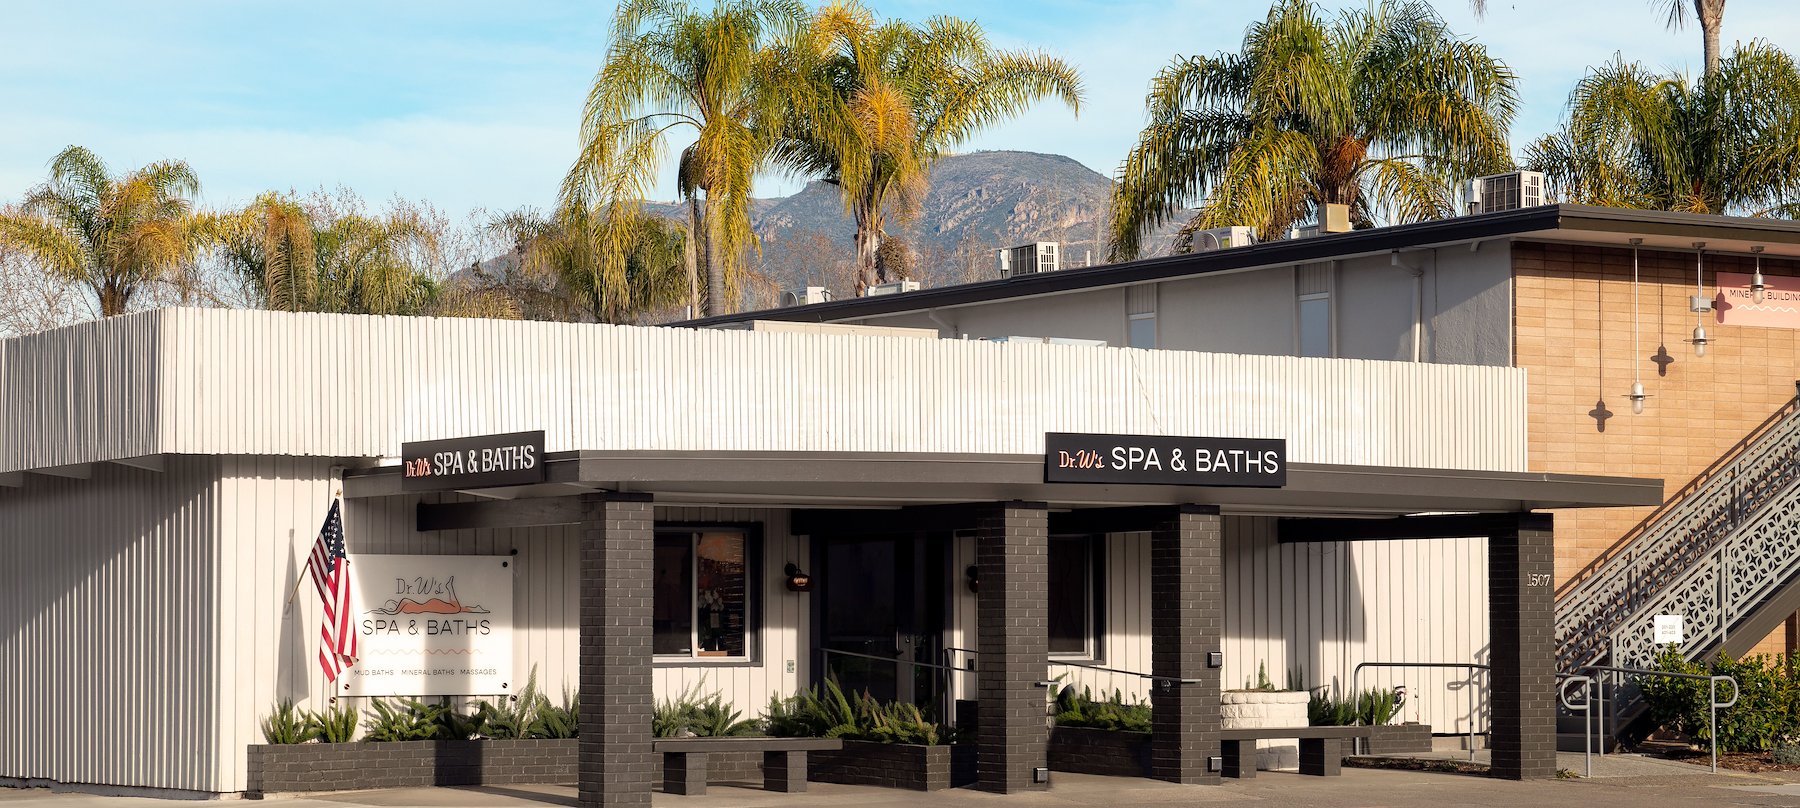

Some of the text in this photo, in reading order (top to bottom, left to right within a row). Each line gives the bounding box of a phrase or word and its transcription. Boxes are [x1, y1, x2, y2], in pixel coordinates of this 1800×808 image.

[1729, 289, 1765, 300] MINE
[434, 451, 464, 476] SPA
[467, 449, 478, 474] &
[482, 444, 535, 473] BATHS
[1111, 446, 1162, 471] SPA
[1170, 448, 1187, 471] &
[1195, 449, 1279, 474] BATHS
[1527, 571, 1550, 586] 1507
[362, 619, 491, 635] SPA & BATHS
